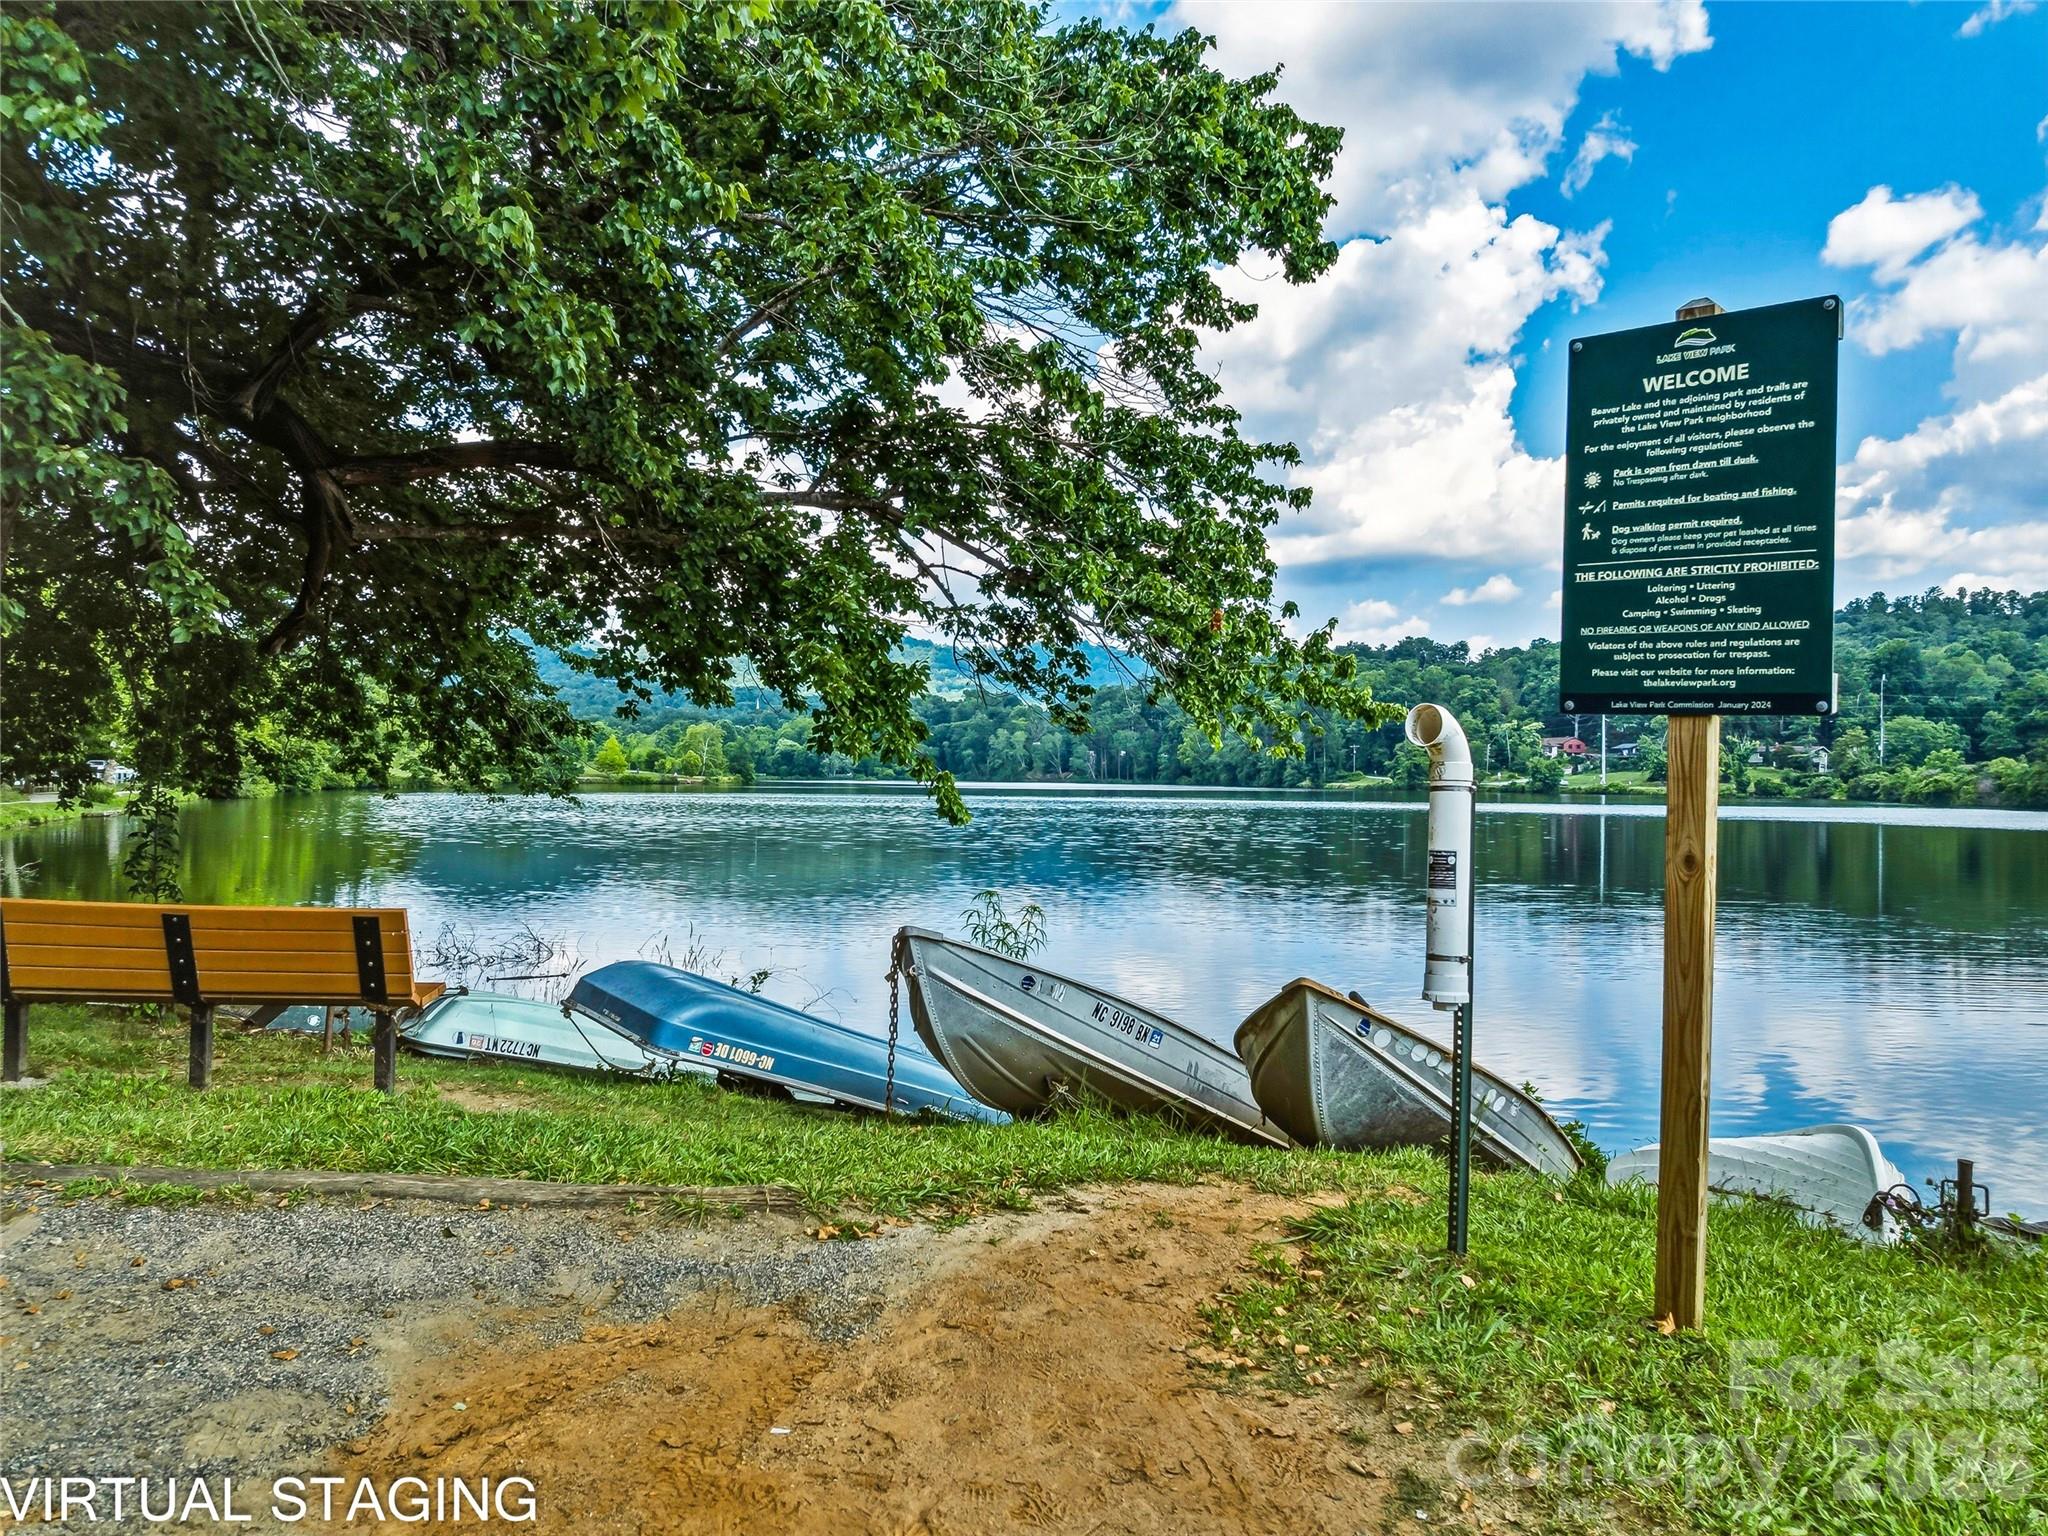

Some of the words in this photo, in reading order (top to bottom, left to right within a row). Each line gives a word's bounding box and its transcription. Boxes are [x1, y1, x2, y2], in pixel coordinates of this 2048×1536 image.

[1656, 352, 1681, 364] LAKE
[1683, 348, 1708, 360] VIEW
[1709, 344, 1736, 356] PARK
[1642, 363, 1749, 393] WELCOME
[1591, 406, 1620, 416] Beaver
[1622, 403, 1641, 412] Lake
[1644, 400, 1660, 409] and
[1662, 398, 1677, 406] the
[1679, 392, 1720, 404] adjoining
[1723, 389, 1744, 399] park
[1746, 385, 1764, 395] and
[1766, 382, 1790, 393] trails
[1792, 381, 1808, 390] are
[1594, 415, 1630, 428] privately
[1632, 410, 1661, 421] owned
[1663, 408, 1680, 417] and
[1682, 401, 1732, 414] maintained
[1734, 400, 1746, 409] by
[1749, 394, 1792, 406] residents
[1794, 391, 1806, 400] of
[1621, 425, 1636, 433] the
[1638, 422, 1658, 431] Lake
[1660, 420, 1682, 428] View
[1684, 415, 1704, 425] Park
[1706, 407, 1772, 423] neighborhood
[1584, 445, 1599, 454] For
[1601, 443, 1614, 451] the
[1663, 435, 1674, 444] of
[1674, 433, 1685, 443] all
[1687, 431, 1722, 441] visitors,
[1725, 428, 1755, 439] please
[1757, 424, 1796, 434] observe
[1798, 420, 1815, 429] the
[1646, 446, 1687, 457] following
[1689, 440, 1743, 453] regulations:
[1613, 468, 1633, 478] Park
[1634, 467, 1642, 475] is
[1644, 465, 1666, 475] open
[1669, 462, 1690, 471] from
[1692, 460, 1717, 469] dawn
[1720, 457, 1731, 467] till
[1734, 454, 1759, 465] dusk.
[1613, 479, 1624, 487] No
[1689, 471, 1709, 479] dark.
[1612, 500, 1645, 510] Permits
[1647, 495, 1685, 508] required
[1687, 494, 1701, 502] for
[1703, 491, 1739, 501] boating
[1741, 488, 1759, 498] and
[1761, 487, 1797, 497] fishing.
[1612, 525, 1630, 534] Dog
[1632, 522, 1666, 532] walking
[1668, 519, 1698, 530] permit
[1700, 516, 1743, 528] required.
[1611, 538, 1627, 546] Dog
[1629, 536, 1655, 544] owners
[1657, 534, 1681, 542] please
[1683, 532, 1702, 541] keep
[1704, 532, 1721, 540] your
[1723, 530, 1737, 539] pet
[1739, 526, 1770, 535] leashed
[1782, 525, 1791, 533] all
[1794, 524, 1817, 532] times
[1619, 546, 1647, 554] dispose
[1649, 544, 1657, 552] of
[1659, 544, 1672, 552] pet
[1706, 538, 1741, 549] provided
[1574, 572, 1595, 582] THE
[1598, 568, 1663, 580] FOLLOWING
[1665, 566, 1688, 577] ARE
[1691, 563, 1740, 576] STRICTLY
[1744, 559, 1819, 572] PROHIBITED:
[1647, 584, 1687, 593] Loitering
[1696, 581, 1736, 591] Littering
[1655, 595, 1689, 604] Alcohol
[1698, 594, 1726, 604] Drugs
[1622, 609, 1660, 619] Camping
[1670, 607, 1717, 617] Swimming
[1727, 605, 1762, 615] Skating
[1580, 627, 1594, 635] NO
[1596, 626, 1637, 635] FIREARMS
[1653, 624, 1698, 633] WEAPONS
[1700, 623, 1713, 631] OF
[1715, 623, 1735, 631] ANY
[1737, 622, 1760, 630] KIND
[1762, 620, 1810, 630] ALLOWED
[1588, 642, 1626, 650] Violators
[1627, 641, 1637, 649] of
[1656, 640, 1683, 648] above
[1685, 640, 1708, 648] rules
[1710, 639, 1727, 647] and
[1729, 638, 1782, 649] regulations
[1613, 652, 1644, 661] subject
[1658, 651, 1710, 661] prosecution
[1713, 650, 1727, 658] for
[1729, 650, 1771, 660] trespass.
[1621, 668, 1638, 676] visit
[1657, 667, 1692, 676] website
[1694, 667, 1708, 675] for
[1737, 666, 1795, 675] information:
[1643, 678, 1736, 688] thelakeviewpark.org
[1718, 701, 1749, 710] January
[1751, 701, 1772, 709] 2024
[1092, 1002, 1109, 1023] NC
[1110, 1011, 1136, 1035] 9198
[500, 1039, 526, 1056] 7722
[527, 1043, 541, 1058] NC
